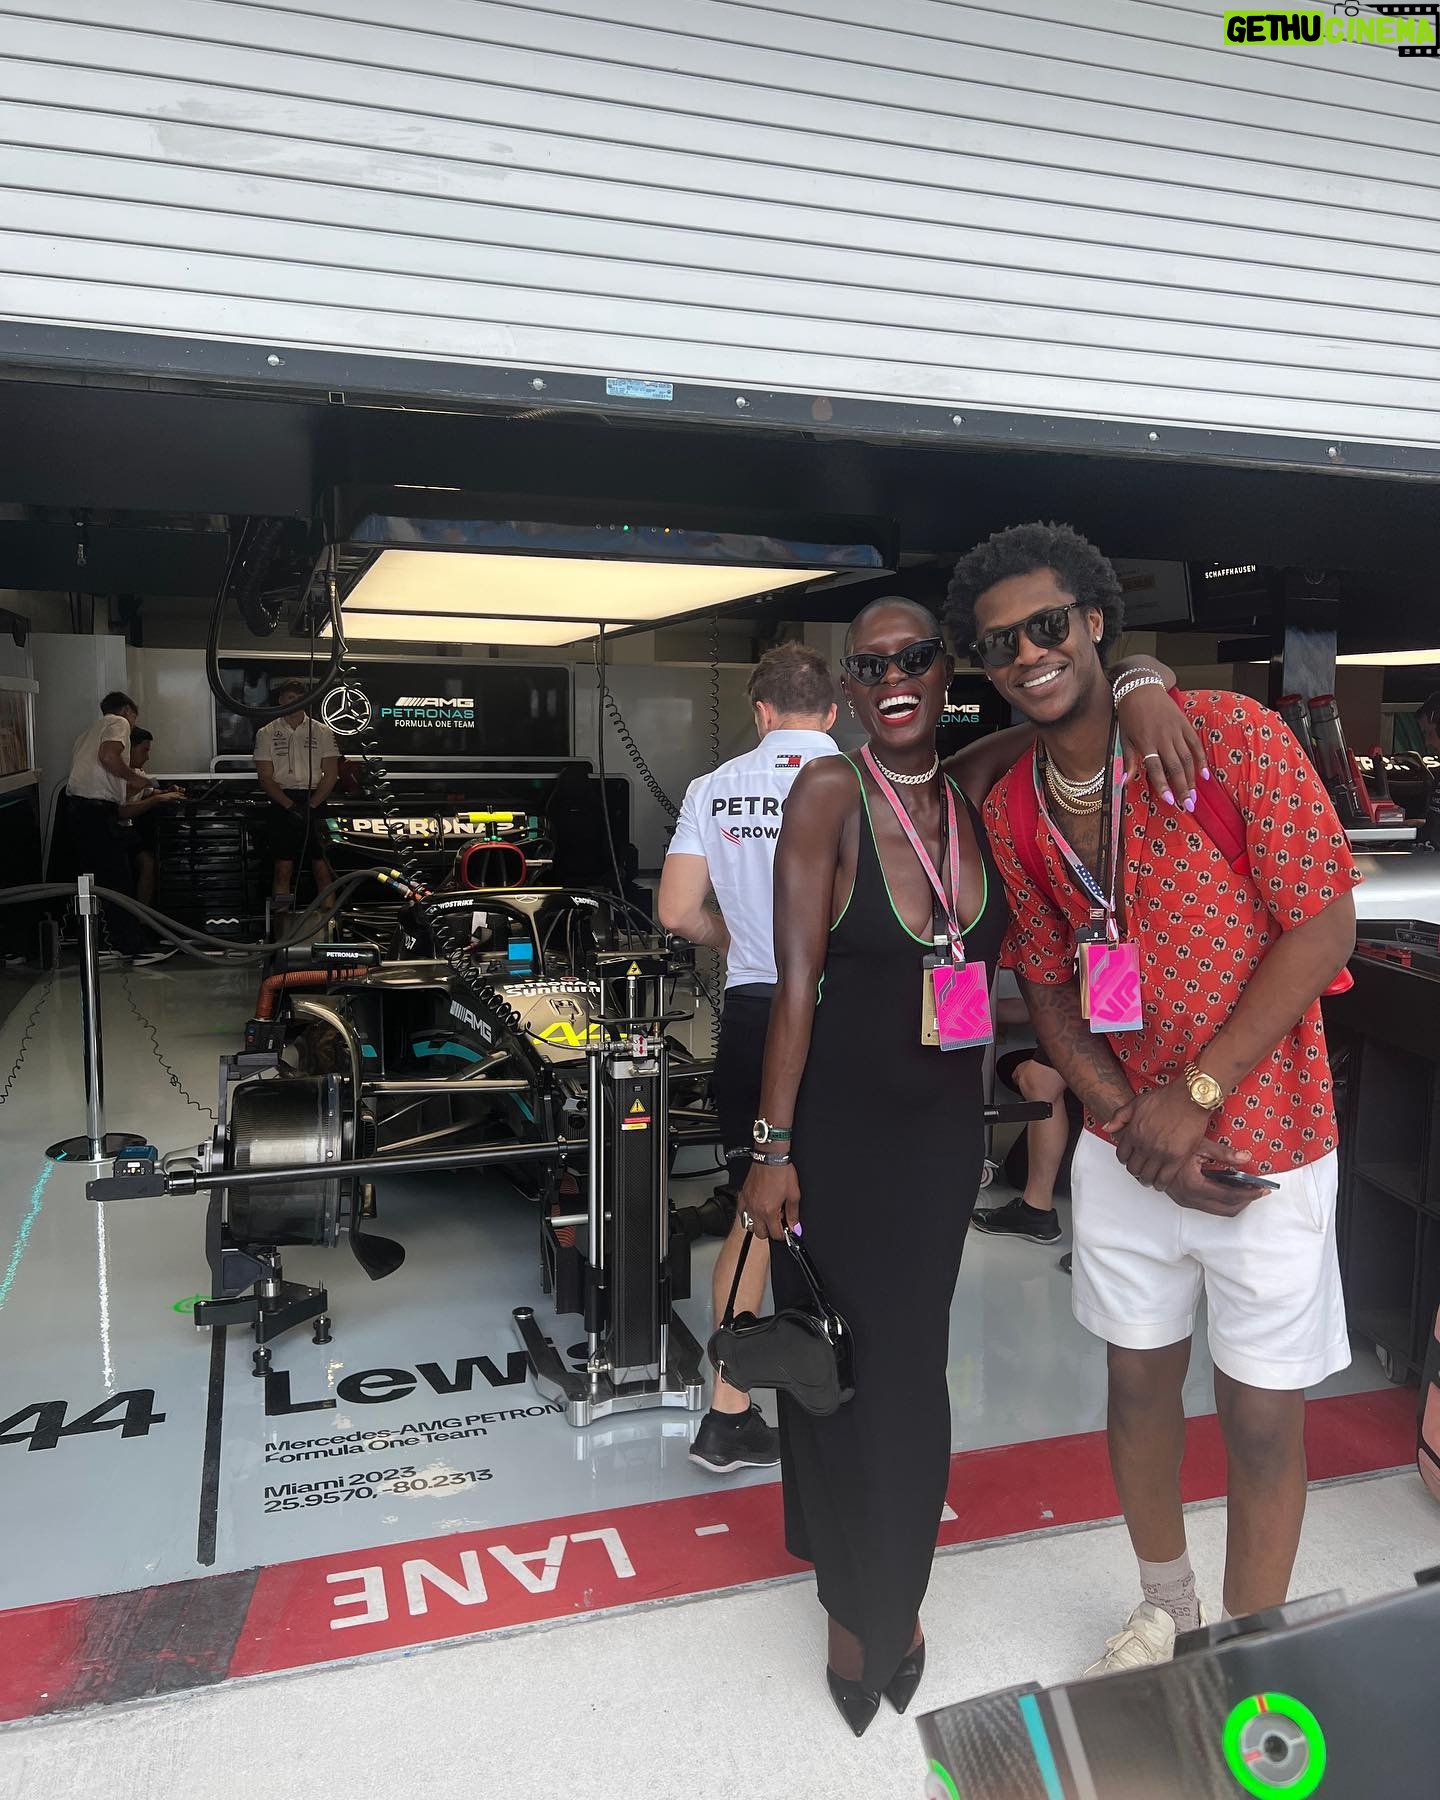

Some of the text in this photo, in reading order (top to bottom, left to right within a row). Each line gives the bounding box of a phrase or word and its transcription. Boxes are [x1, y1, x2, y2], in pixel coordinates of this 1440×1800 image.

[1204, 564, 1257, 579] SCHAFFHAUSEN
[381, 708, 475, 719] PETRONAS
[421, 697, 475, 708] AMG
[394, 719, 475, 729] FORMULA ONE TEAM
[938, 714, 980, 723] ONAS
[711, 796, 788, 817] PETR
[326, 951, 359, 959] PETRONAS
[462, 1006, 492, 1044] AMG
[0, 1388, 166, 1451] 44
[264, 1404, 568, 1452] Mercedes-AMG PETRON
[264, 1427, 488, 1464] Formula One Team
[263, 1468, 494, 1514] 25.9570, -80.2313
[264, 1465, 417, 1499] Miami 2023
[326, 1527, 637, 1631] LANE
